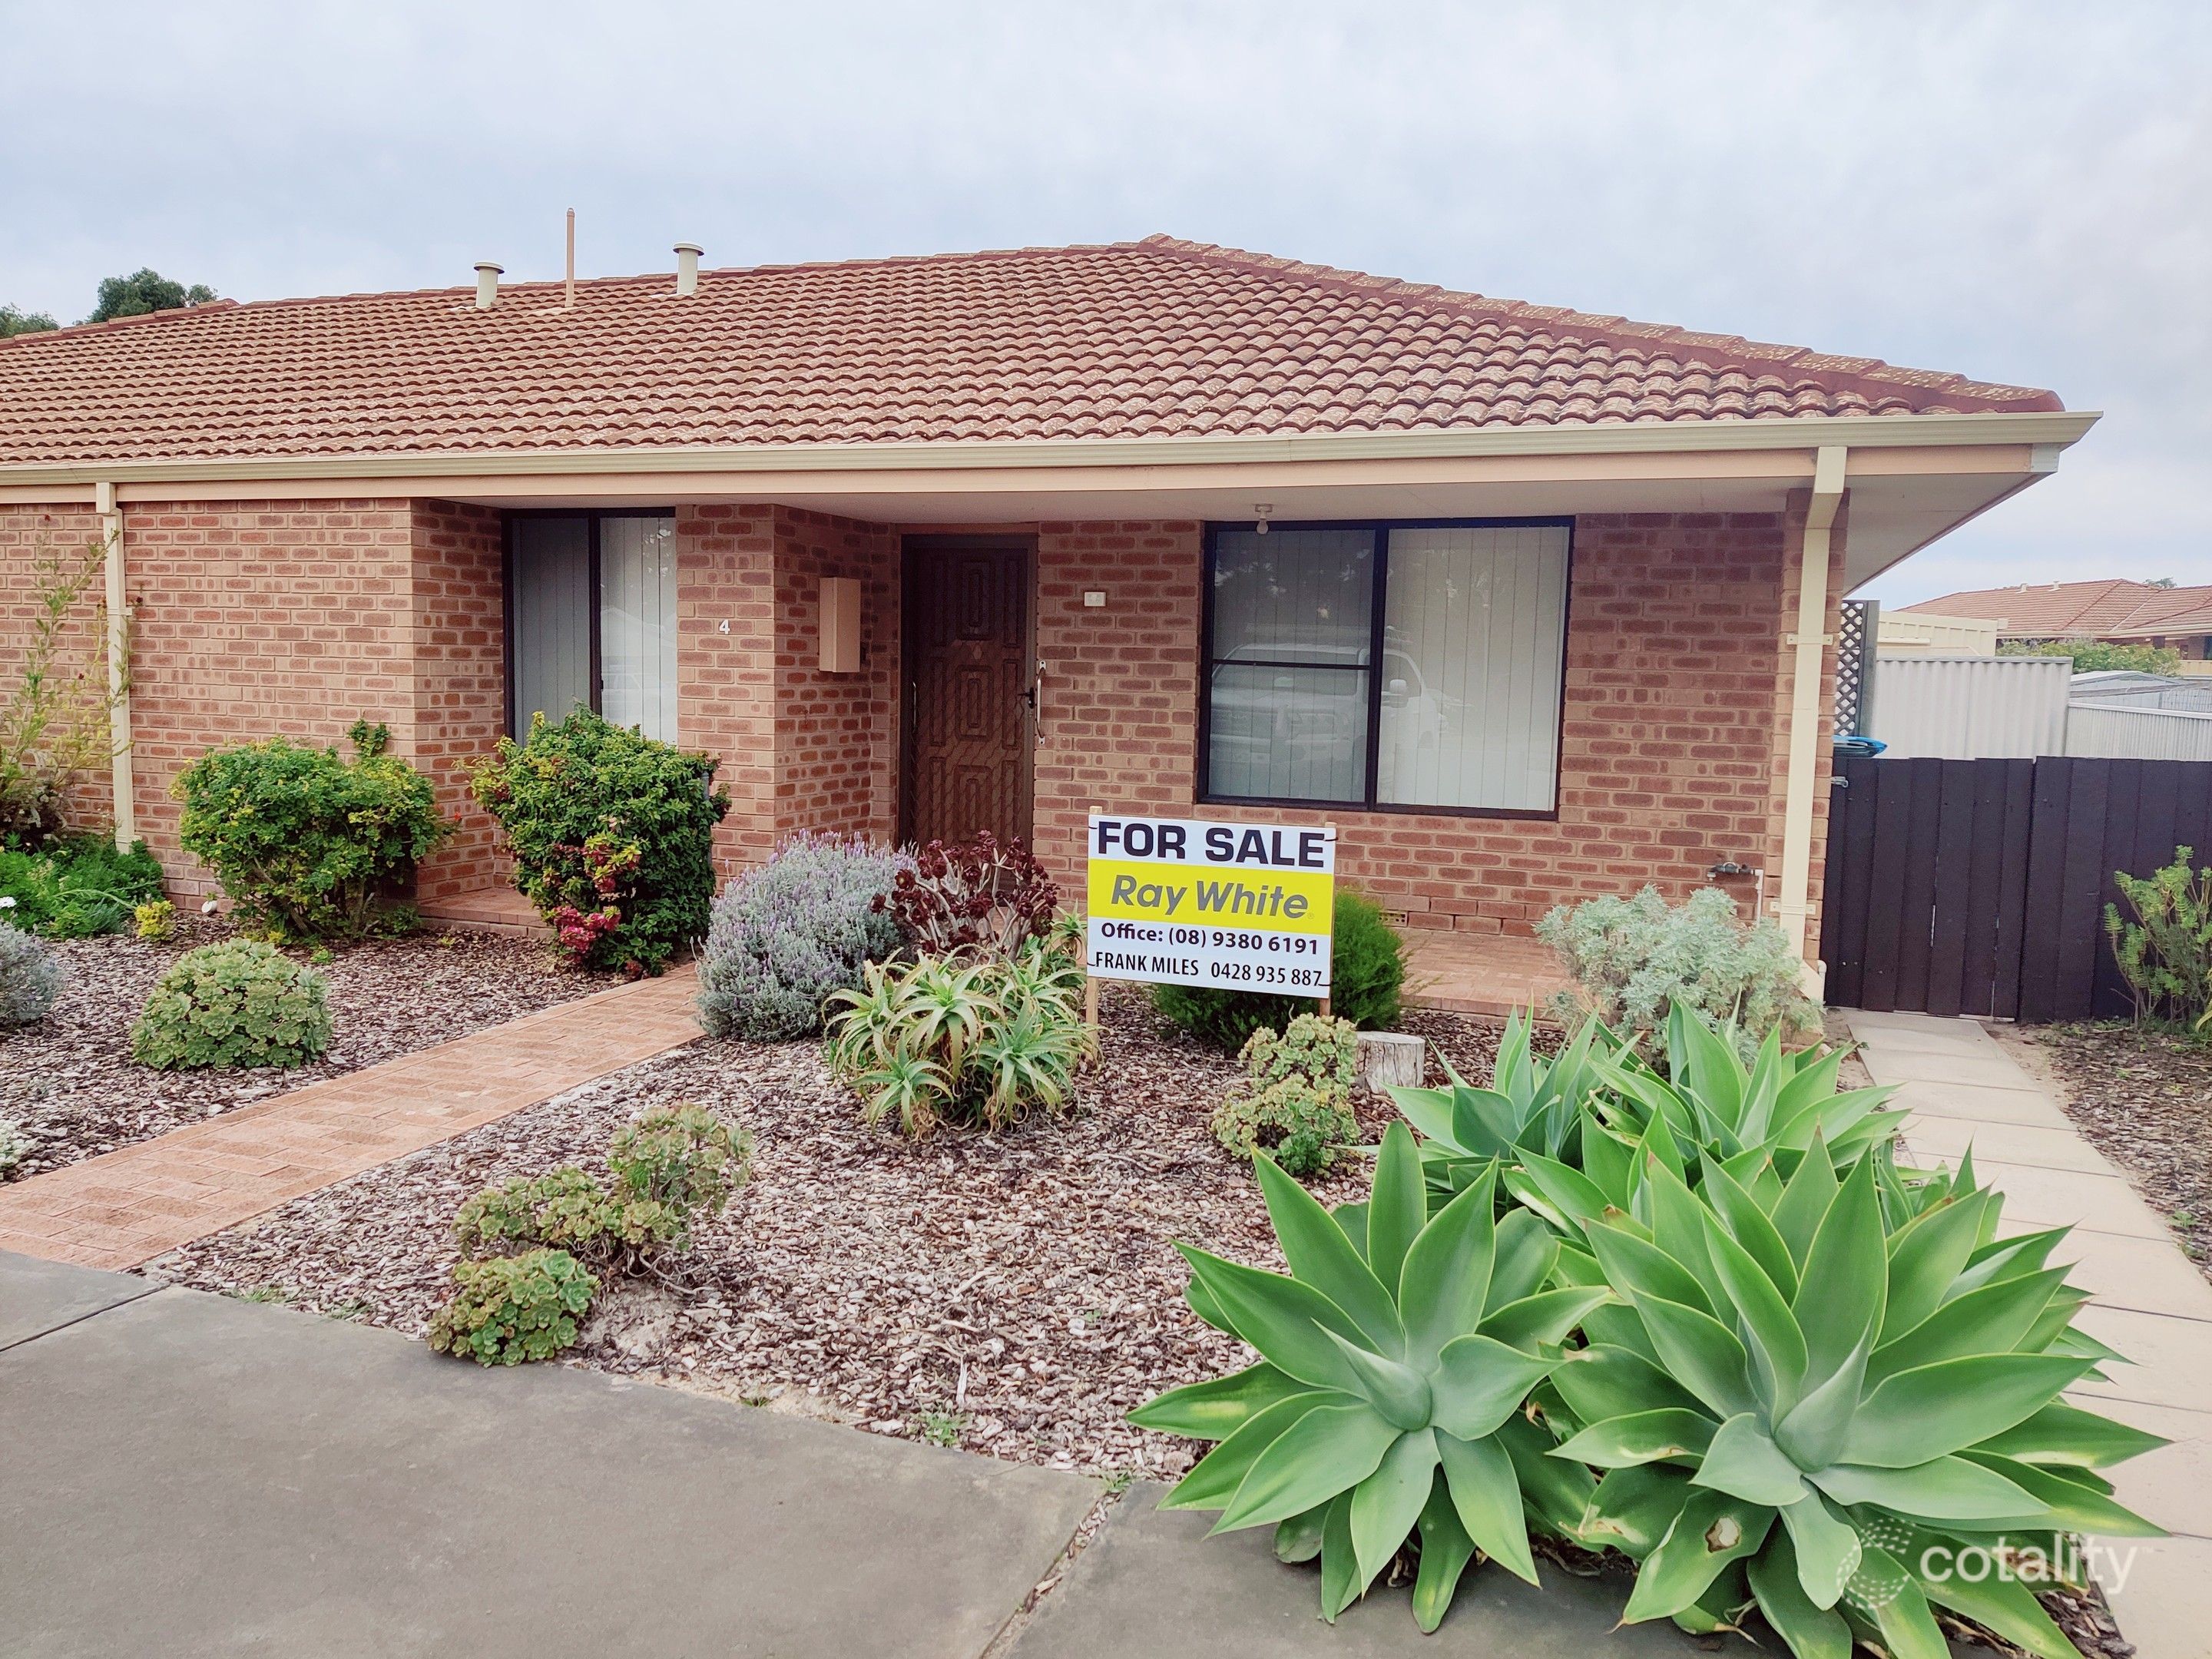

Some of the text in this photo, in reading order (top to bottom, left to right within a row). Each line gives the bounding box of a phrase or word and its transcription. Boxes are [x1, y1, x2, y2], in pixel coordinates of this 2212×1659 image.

[719, 619, 730, 634] 4
[1098, 820, 1325, 867] FOR SALE
[1111, 874, 1309, 919] Ray White
[1101, 922, 1318, 955] Office: (08) 9380 6191
[1095, 952, 1323, 987] FRANK MILES 0428 935 887
